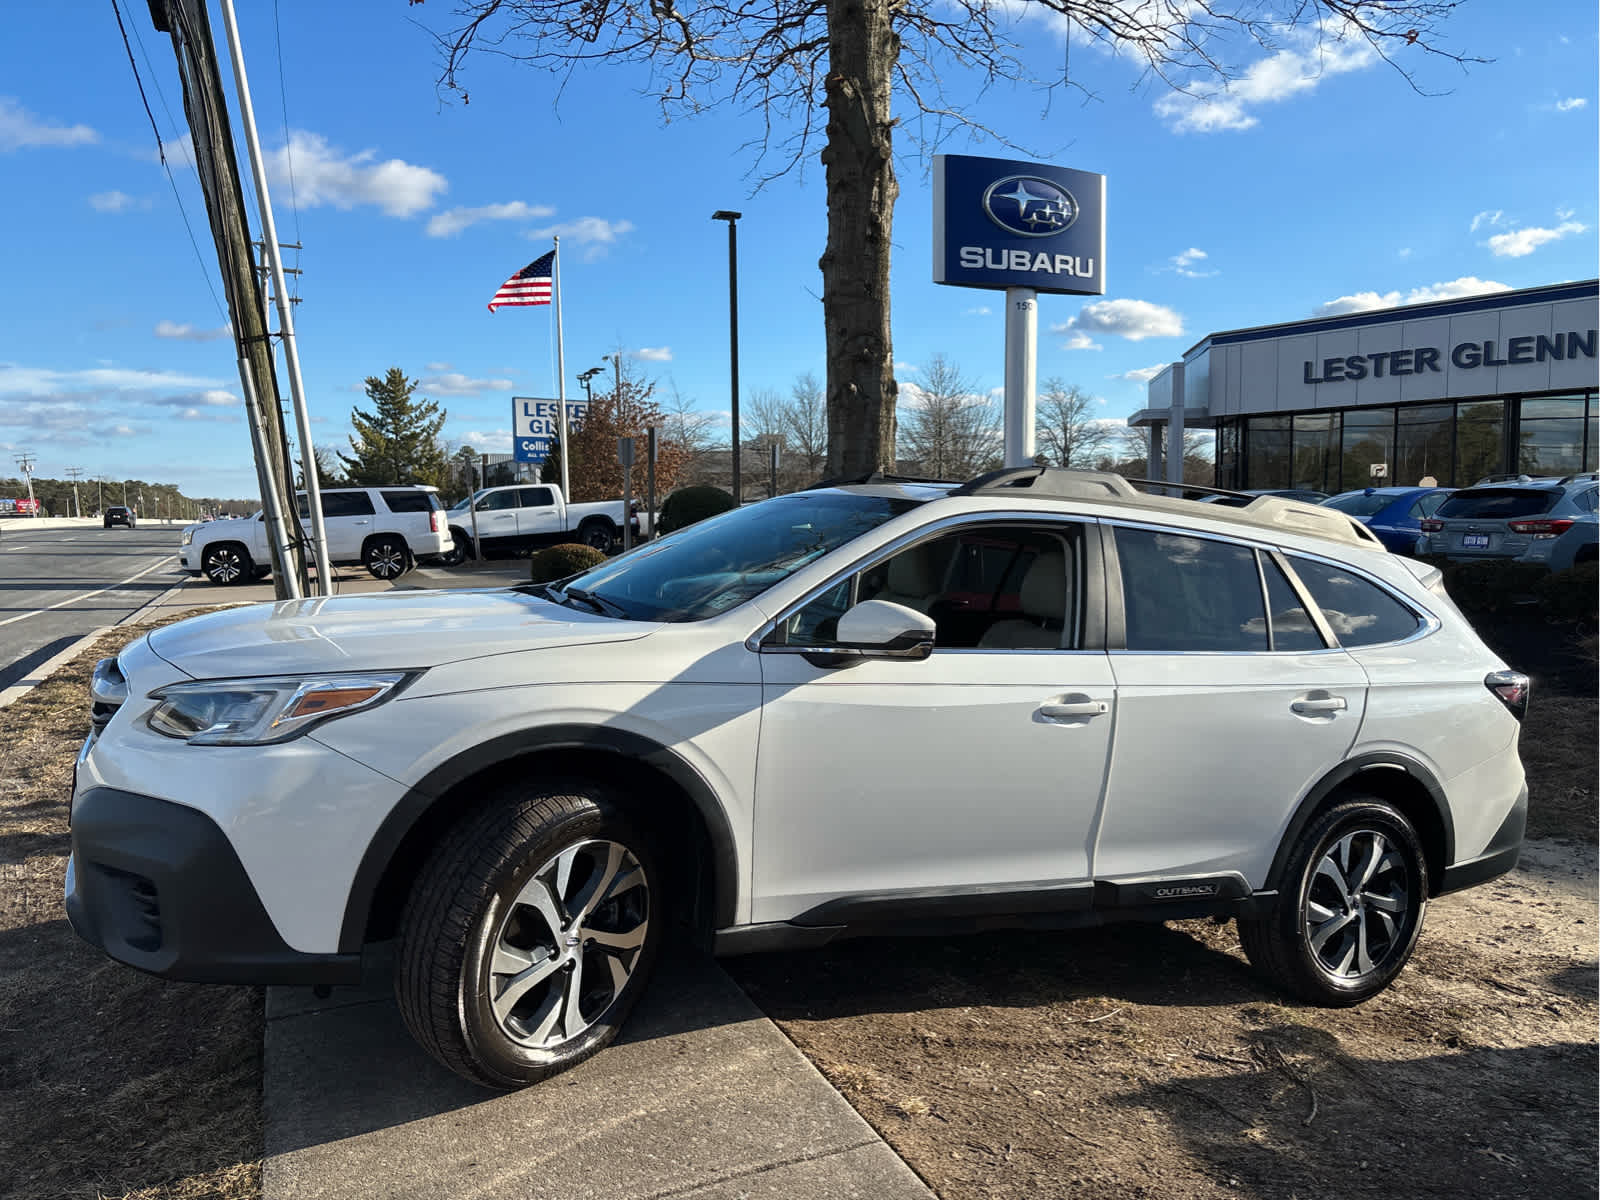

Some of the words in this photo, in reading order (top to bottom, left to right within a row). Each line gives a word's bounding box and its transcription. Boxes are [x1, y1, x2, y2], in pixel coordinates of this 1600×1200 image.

[959, 246, 1094, 279] SUBARU
[1303, 347, 1441, 385] LESTER
[1451, 329, 1599, 370] GLENN
[524, 402, 587, 419] LESTE
[1157, 885, 1214, 896] OUTBACK
